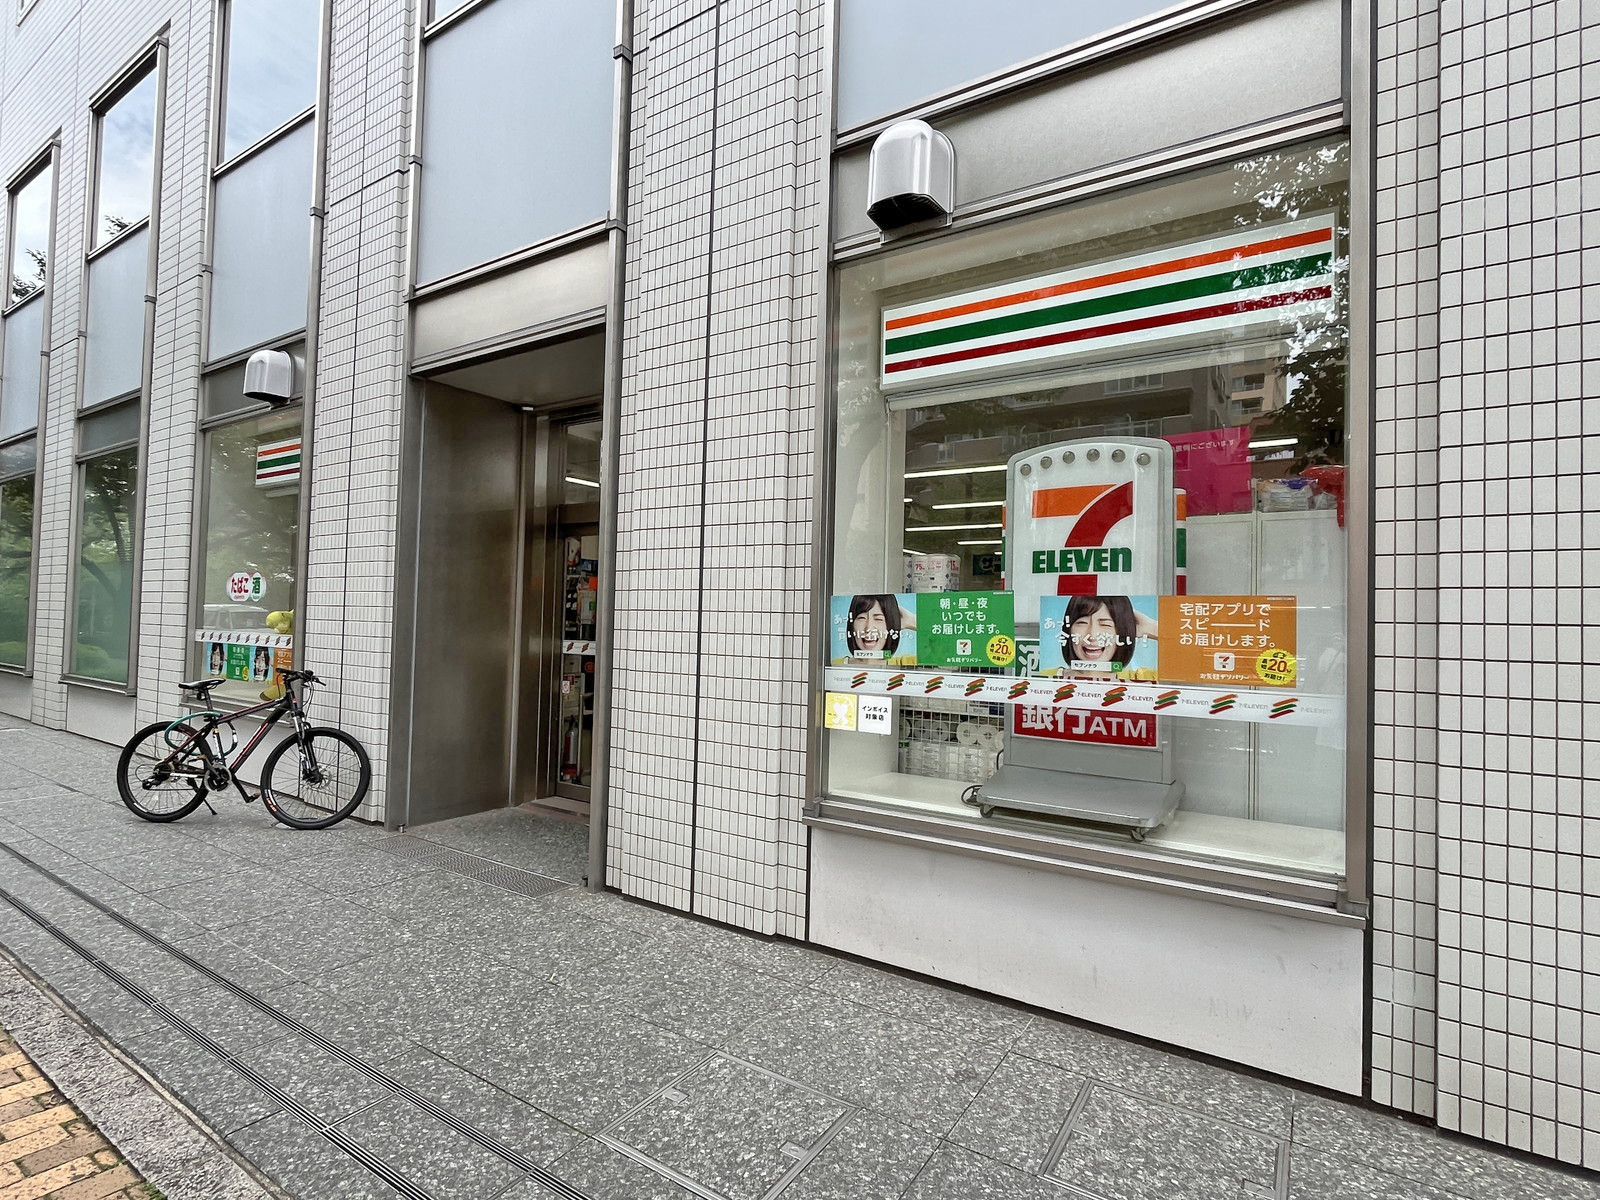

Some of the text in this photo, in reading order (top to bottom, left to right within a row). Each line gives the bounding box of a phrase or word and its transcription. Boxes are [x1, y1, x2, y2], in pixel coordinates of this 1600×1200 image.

[231, 576, 249, 593] たばこ
[252, 577, 261, 594] 酒
[1180, 602, 1272, 616] 宅配アプリで
[941, 611, 987, 622] いつでも
[931, 624, 1000, 635] お届けします。
[1180, 633, 1275, 648] お届けします。
[862, 705, 889, 713] インボイス
[1022, 703, 1147, 738] 銀行ATM
